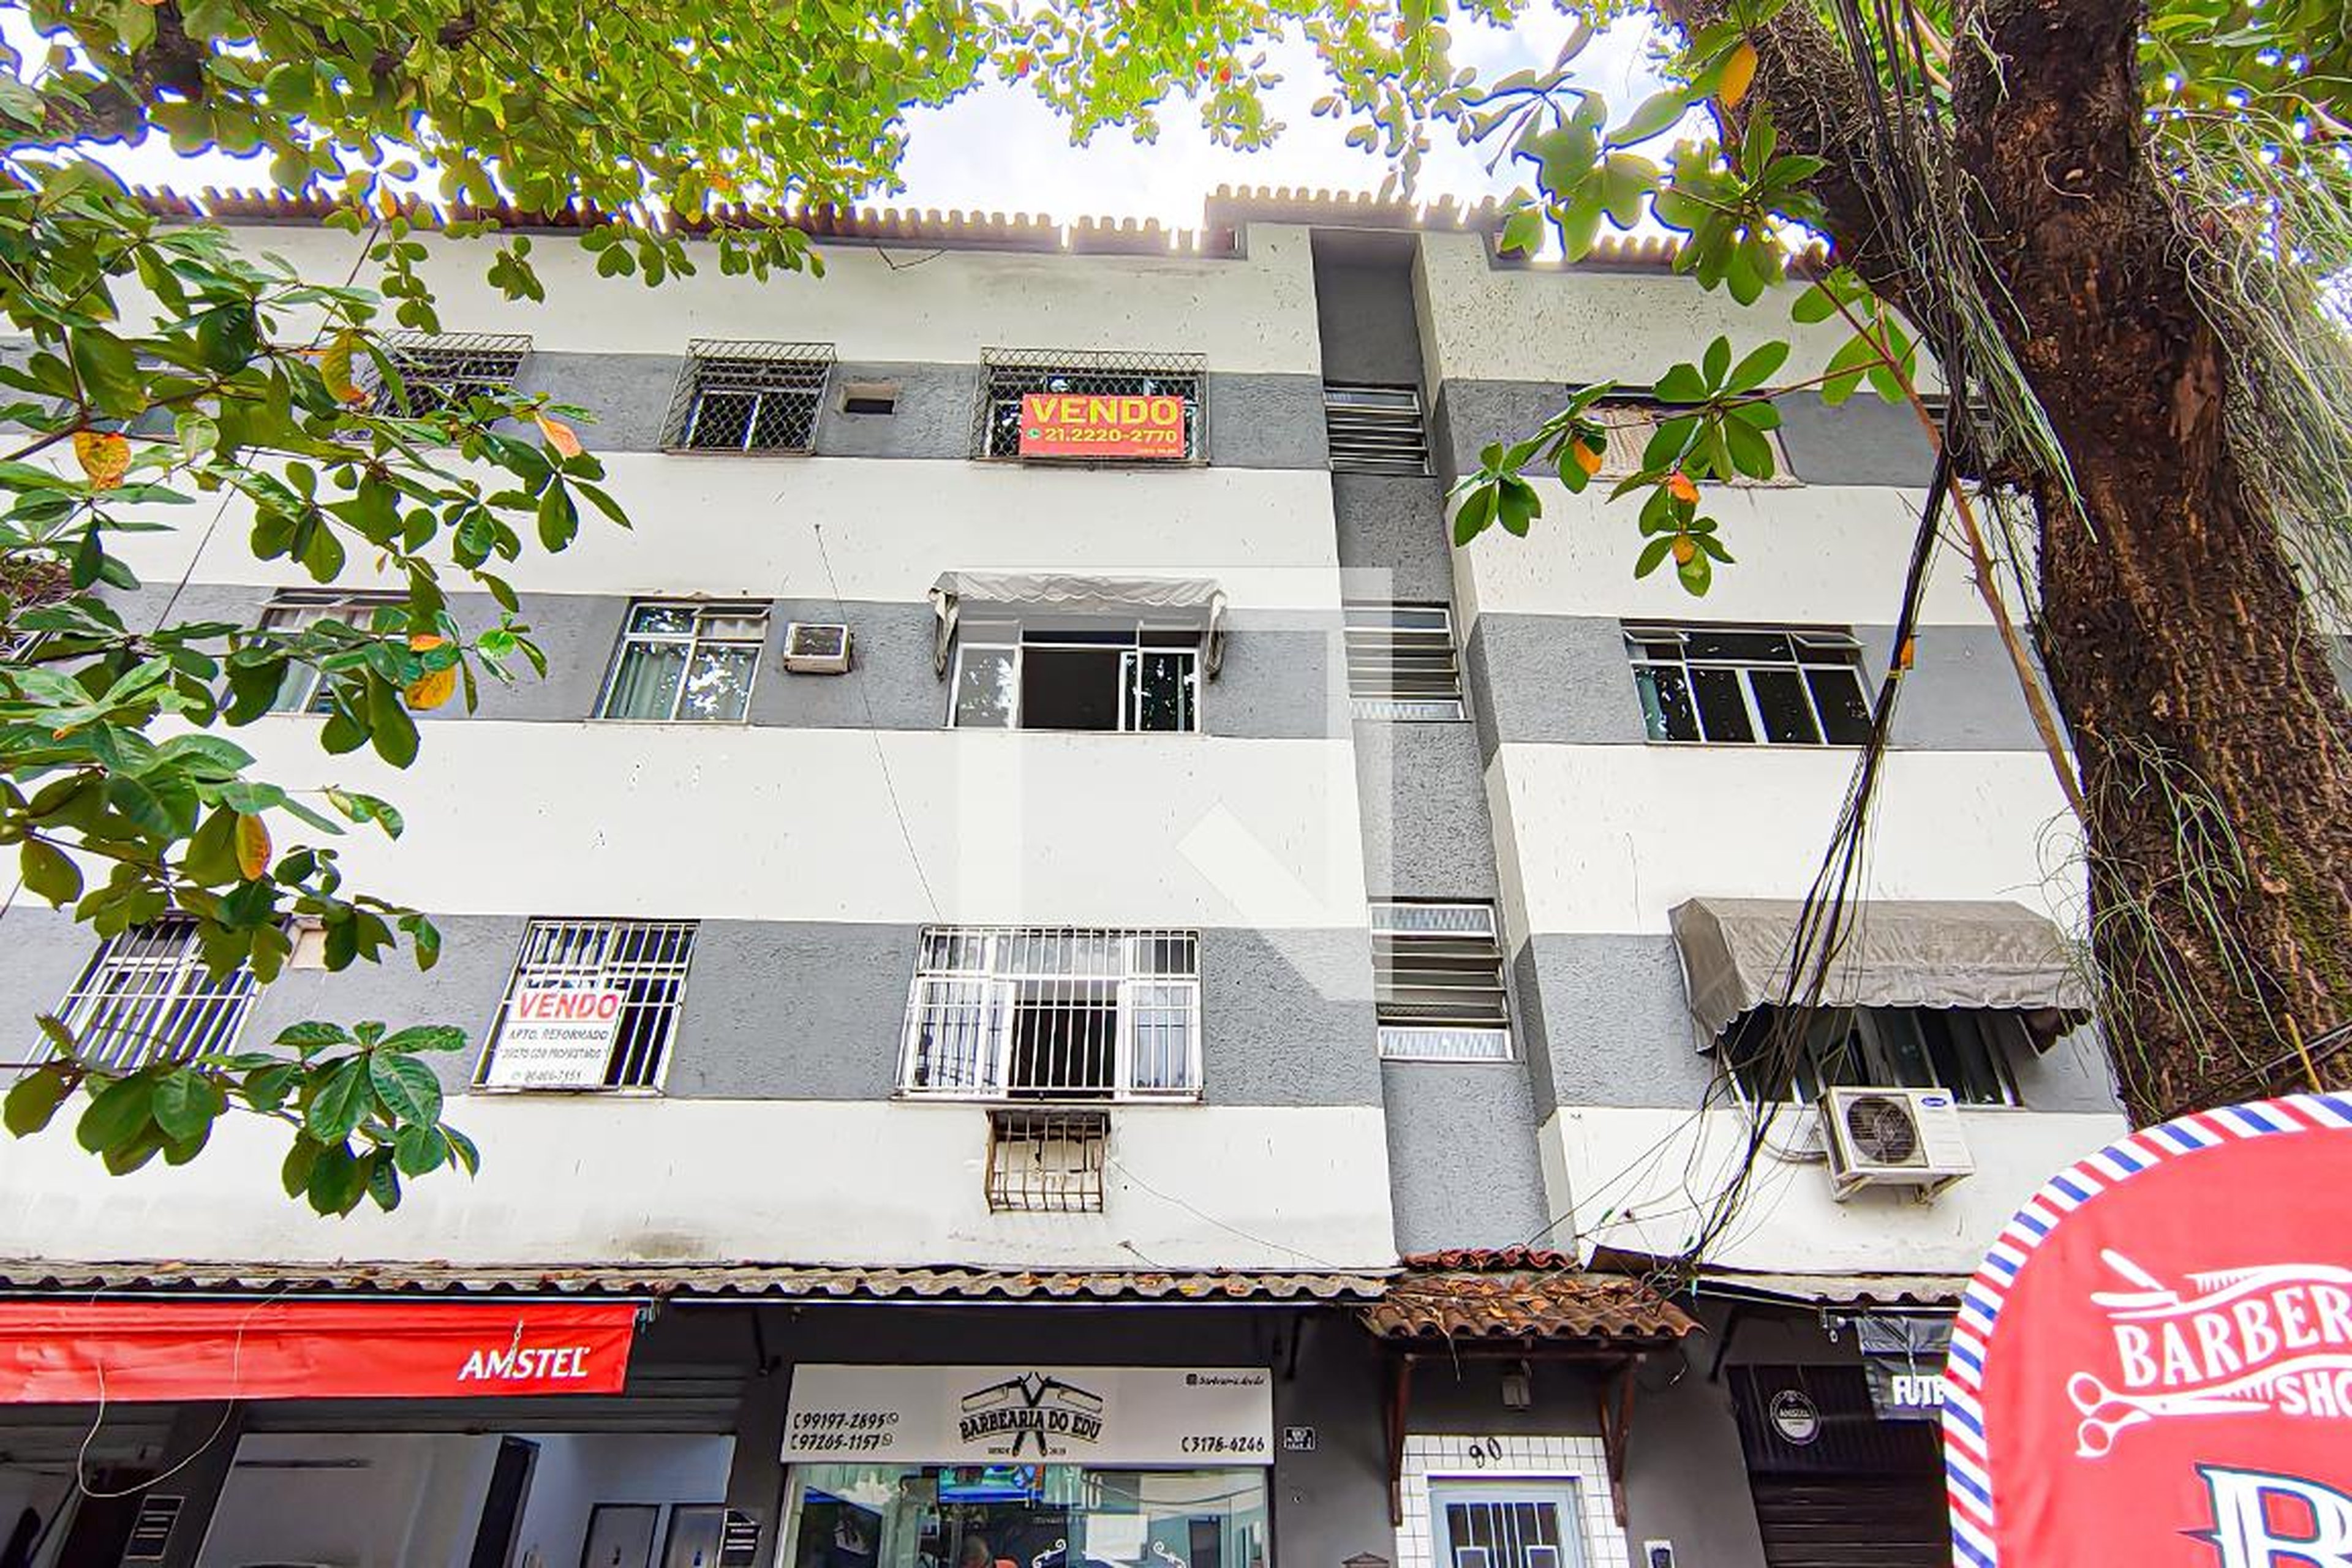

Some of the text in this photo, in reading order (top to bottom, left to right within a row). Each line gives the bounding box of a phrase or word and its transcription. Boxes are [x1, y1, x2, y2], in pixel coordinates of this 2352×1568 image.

[1030, 398, 1178, 425] VENDO
[1045, 428, 1177, 442] 21.2220-2770
[520, 992, 619, 1019] VENDO
[2113, 1285, 2352, 1387] BARBER
[458, 1348, 589, 1381] AMSTEL
[959, 1411, 1102, 1439] BARBEARIA DO EDU
[1469, 1437, 1502, 1468] 90
